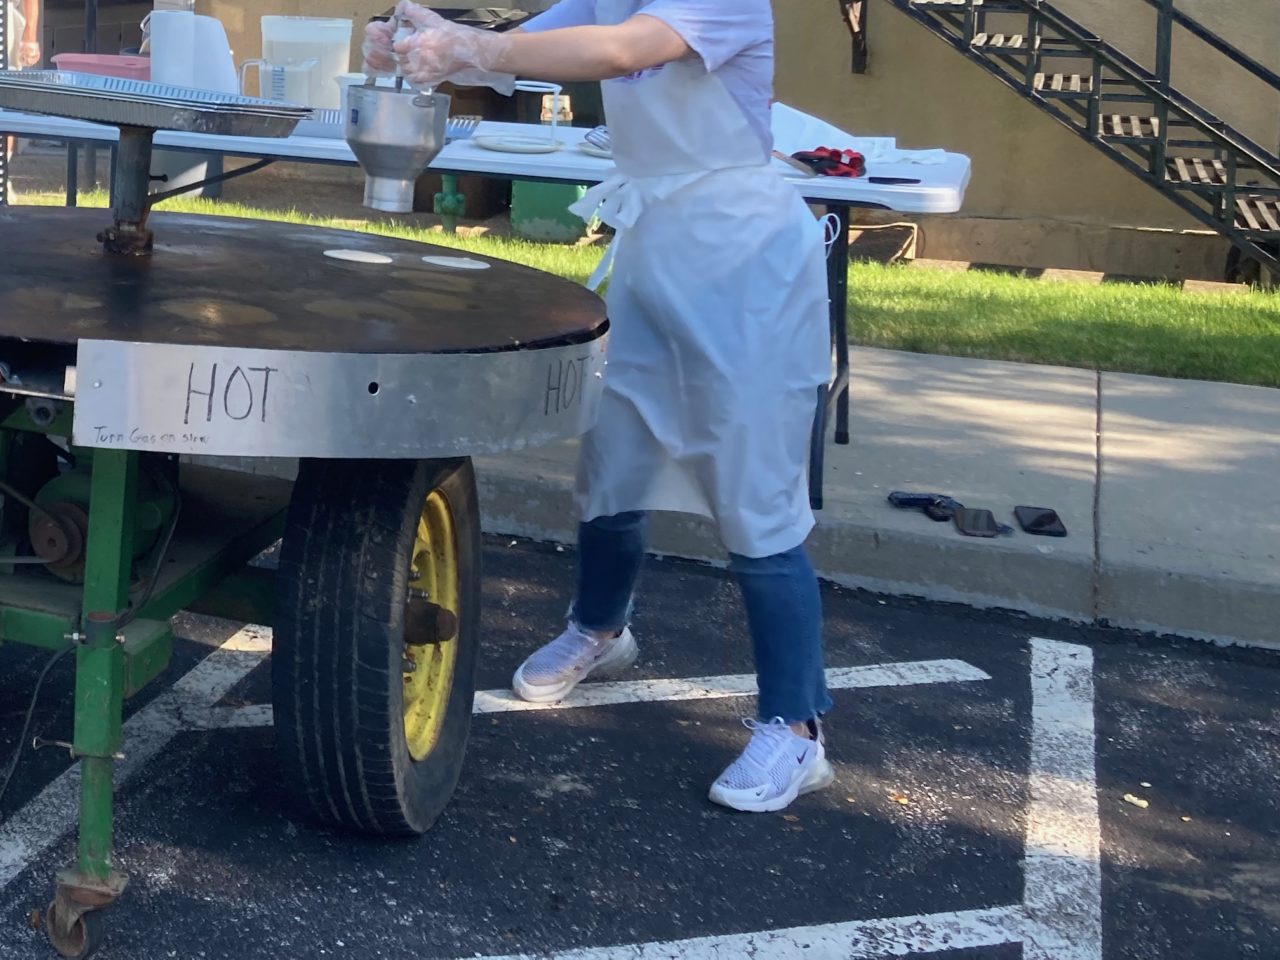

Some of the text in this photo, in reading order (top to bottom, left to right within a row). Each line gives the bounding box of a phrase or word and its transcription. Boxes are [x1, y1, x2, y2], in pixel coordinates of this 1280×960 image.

[184, 361, 278, 425] HOT
[545, 356, 591, 415] HOT
[93, 425, 124, 444] Turn
[129, 427, 156, 444] Gas
[160, 433, 176, 443] on
